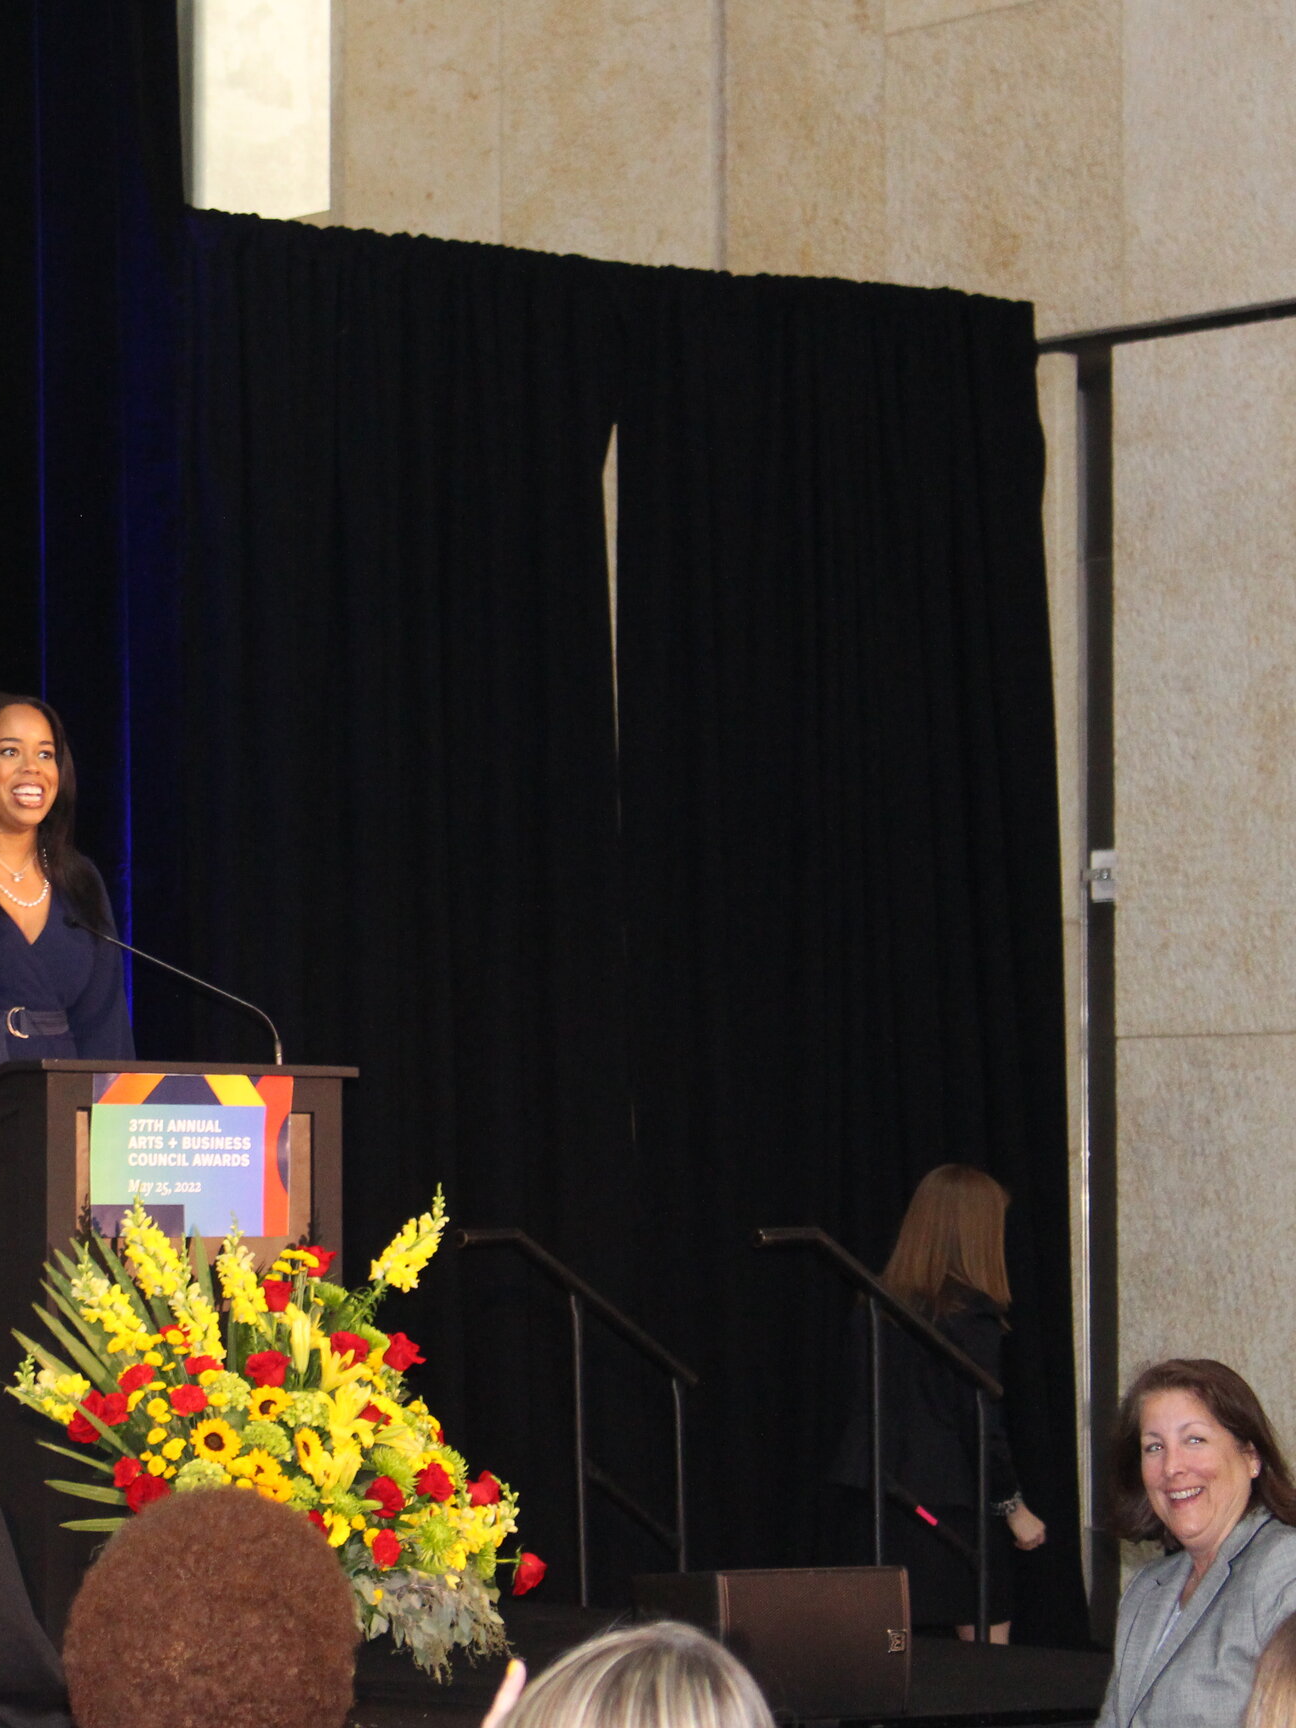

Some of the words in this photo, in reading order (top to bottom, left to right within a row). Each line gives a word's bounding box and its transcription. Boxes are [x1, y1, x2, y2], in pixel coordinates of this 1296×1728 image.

[128, 1119, 164, 1132] 37TH
[167, 1119, 222, 1133] ANNUAL
[128, 1136, 164, 1149] ARTS
[182, 1136, 252, 1150] BUSINESS
[128, 1153, 189, 1167] COUNCIL
[192, 1153, 250, 1167] AWARDS
[128, 1179, 154, 1196] May
[155, 1182, 172, 1196] 25,
[174, 1182, 202, 1193] 2022
